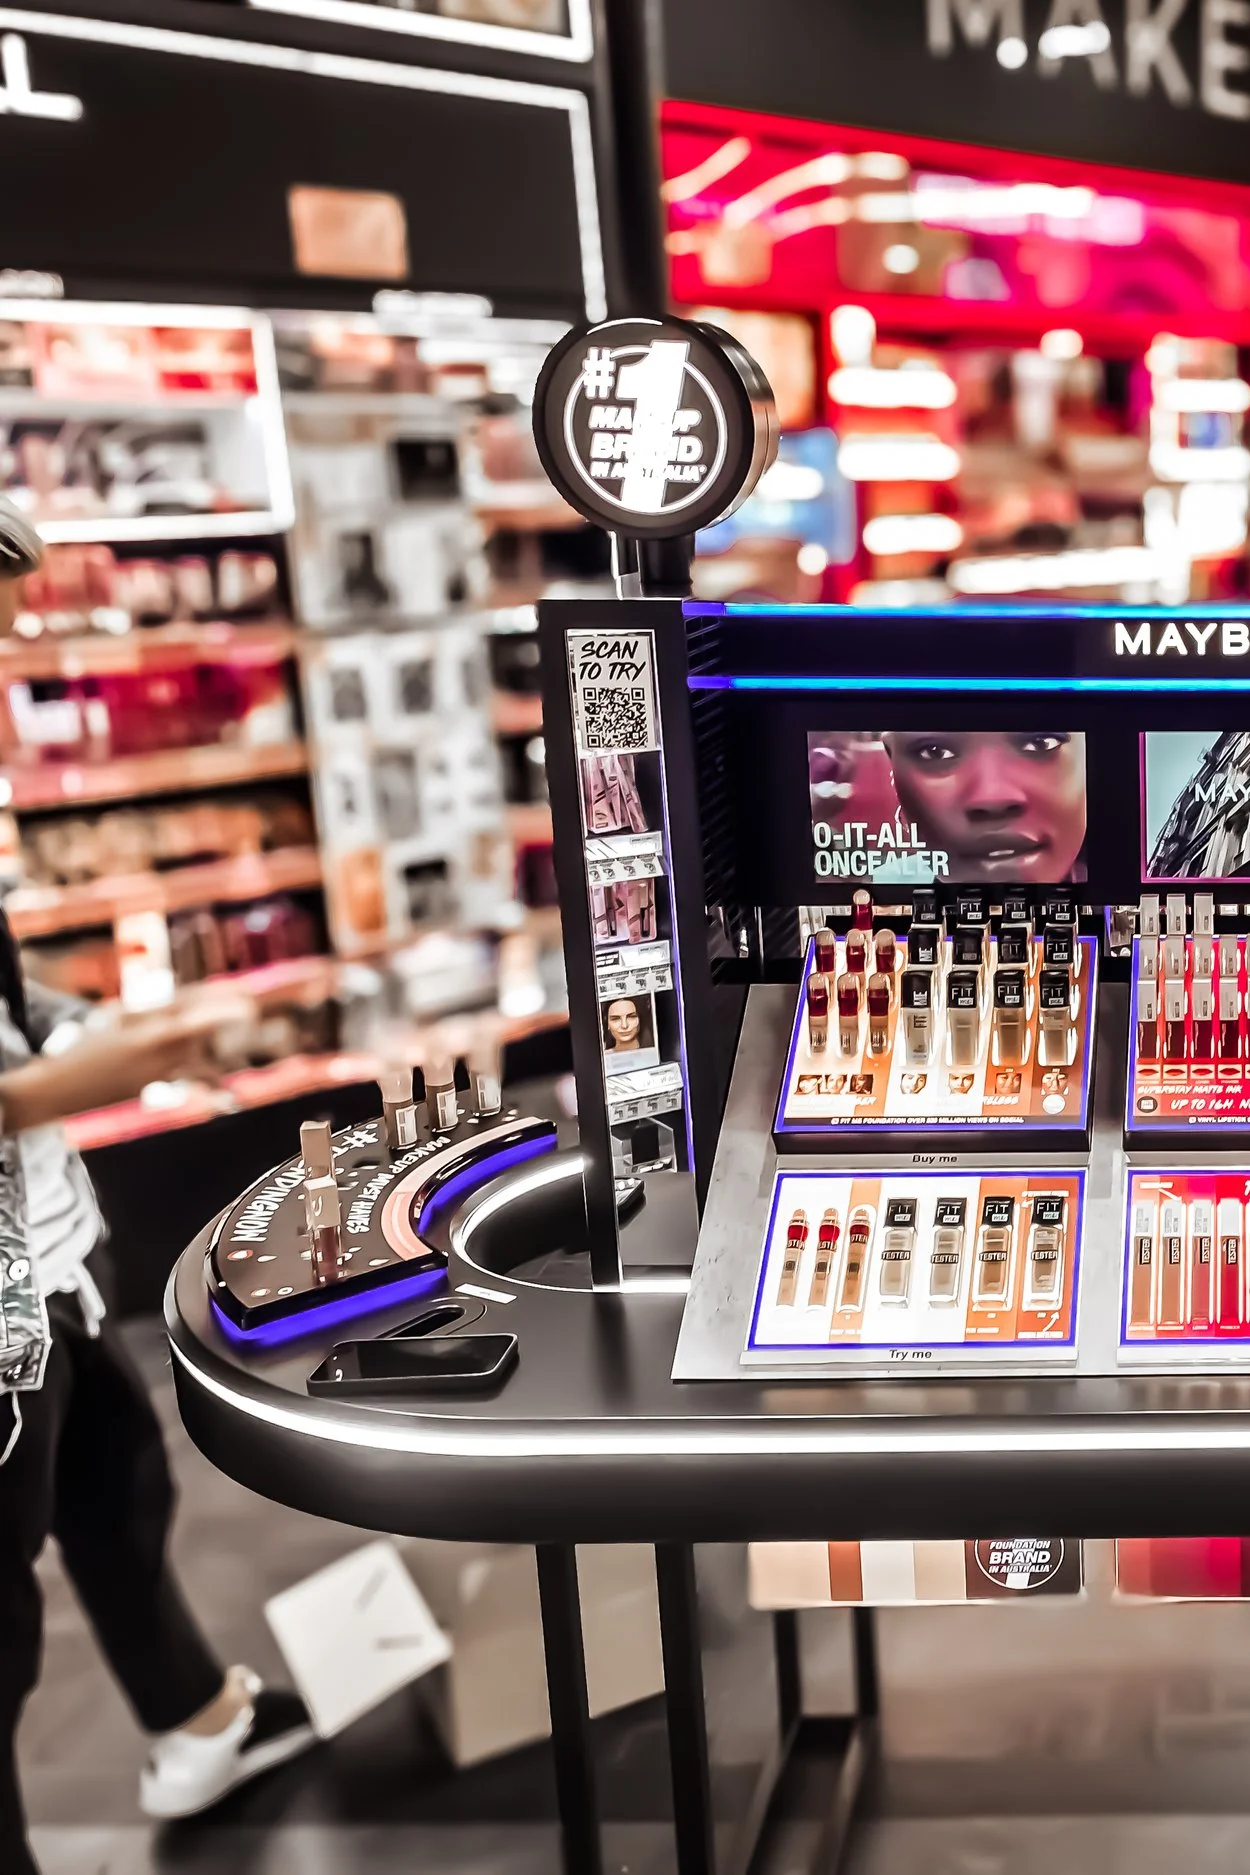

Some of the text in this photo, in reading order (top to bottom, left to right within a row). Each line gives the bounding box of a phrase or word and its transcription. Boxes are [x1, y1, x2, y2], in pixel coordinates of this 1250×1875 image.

[581, 640, 639, 659] SCAN
[579, 661, 646, 682] TO TRY
[814, 850, 950, 877] ONCEALER
[961, 902, 981, 915] FIT
[1050, 903, 1070, 915] FIT
[1046, 943, 1068, 957] FIT
[951, 987, 973, 1000] FIT
[997, 985, 1019, 998] FIT
[1041, 987, 1063, 1000] FIT
[1171, 1099, 1189, 1110] UP
[1190, 1099, 1206, 1110] TO
[912, 1154, 957, 1165] Buy me
[888, 1205, 911, 1216] FIT
[937, 1205, 960, 1217] FIT
[985, 1204, 1008, 1217] FIT
[1037, 1202, 1060, 1215] FIT
[889, 1350, 932, 1361] Try me
[989, 1540, 1051, 1550] FOUNDATION
[989, 1551, 1051, 1565] BRAND
[988, 1565, 999, 1573] IN
